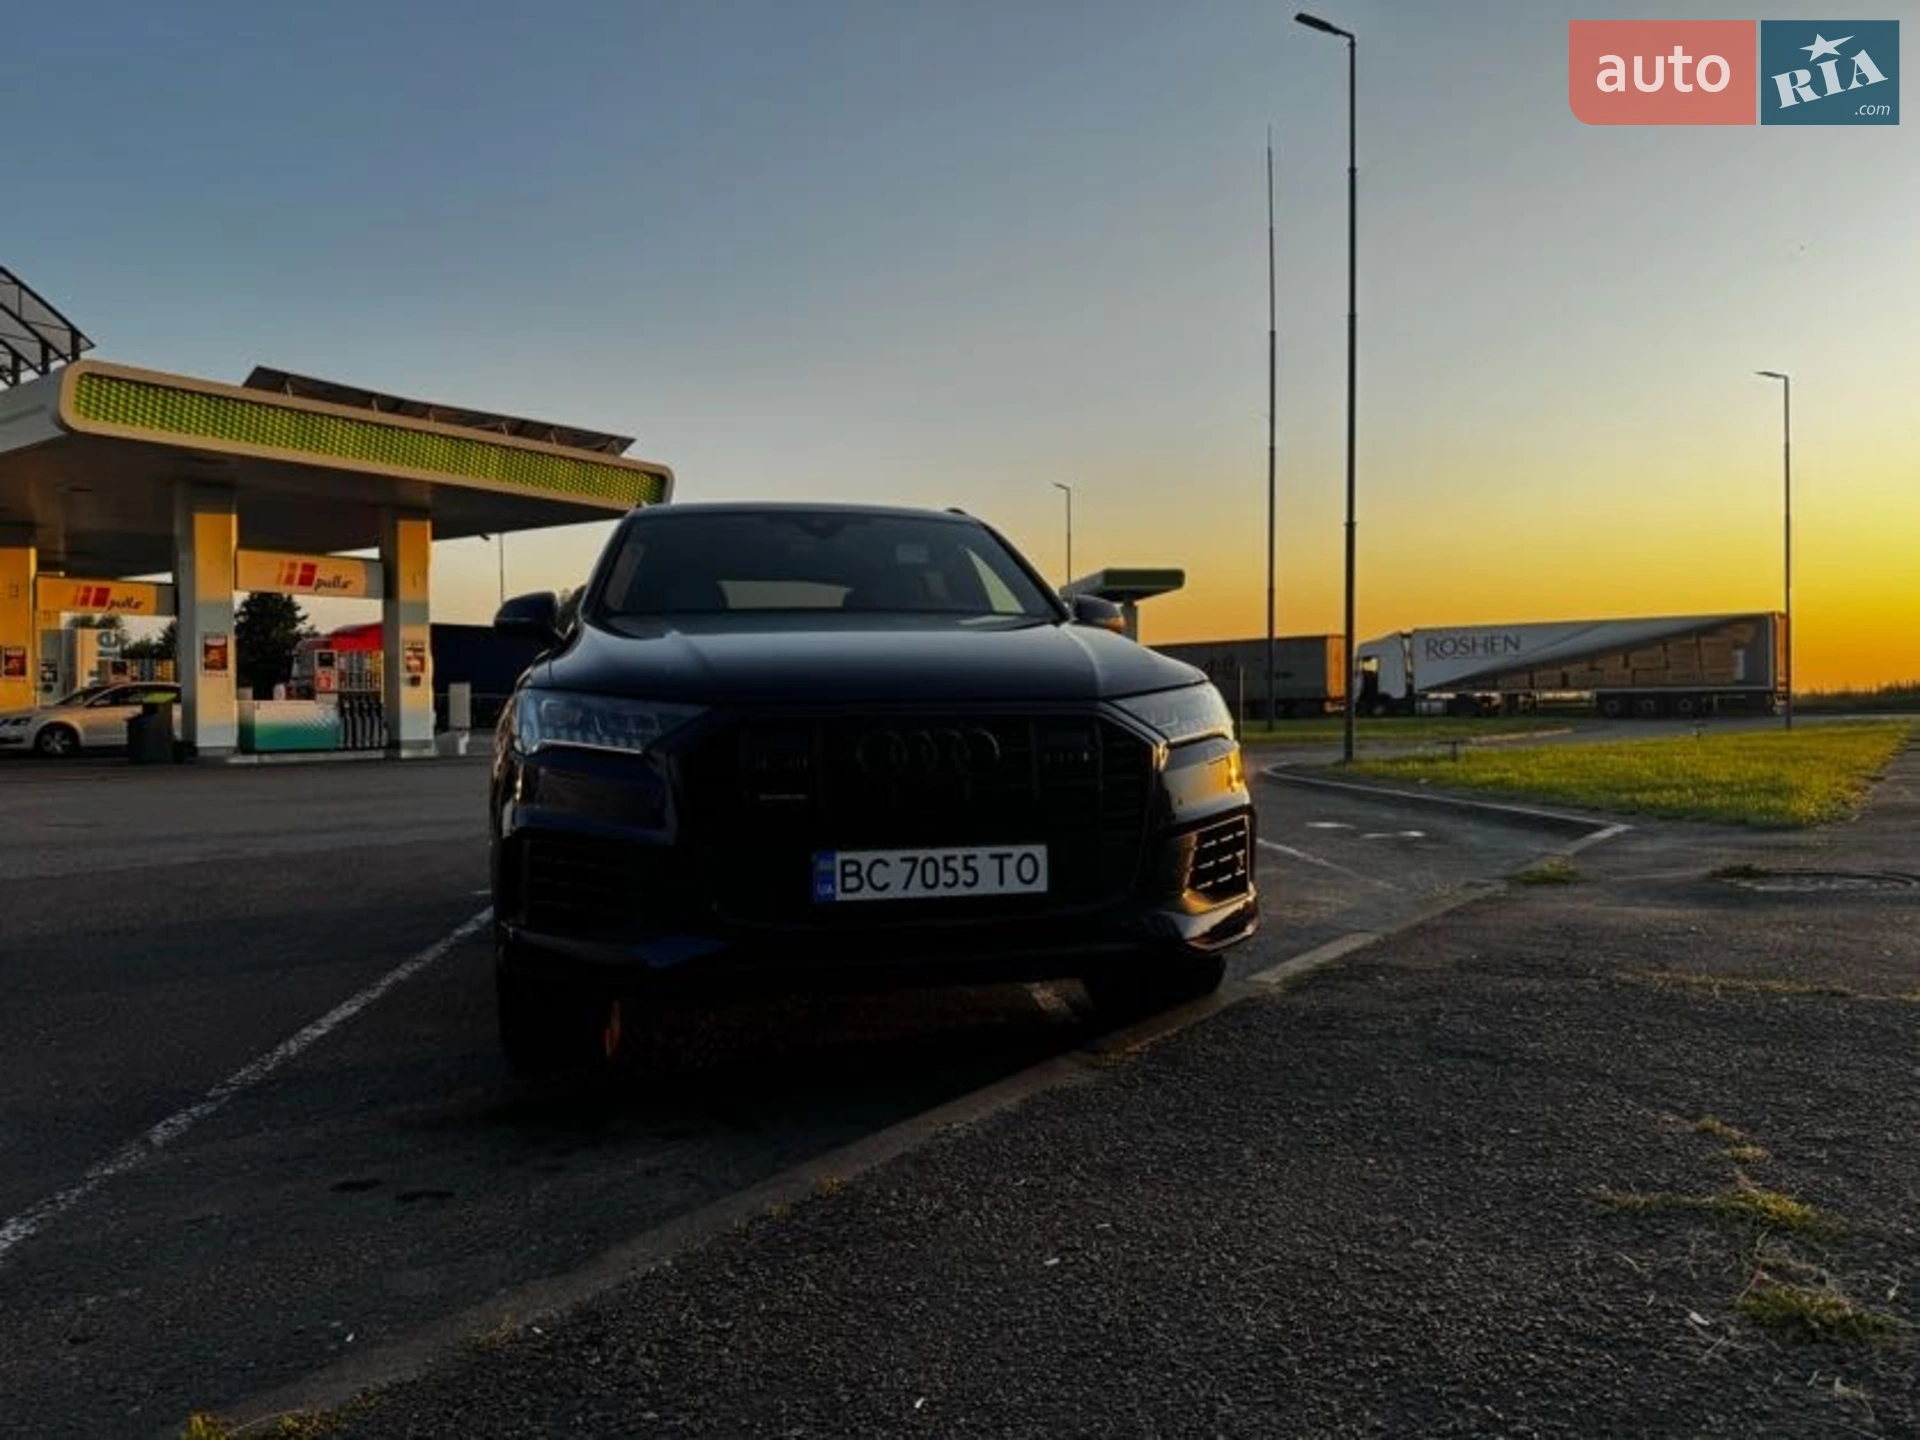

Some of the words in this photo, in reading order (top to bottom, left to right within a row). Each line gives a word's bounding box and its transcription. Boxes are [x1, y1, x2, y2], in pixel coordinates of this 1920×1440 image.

[1425, 635, 1521, 661] ROSHEN
[840, 857, 890, 894] BC
[900, 853, 980, 891] 7055
[988, 852, 1040, 886] TO
